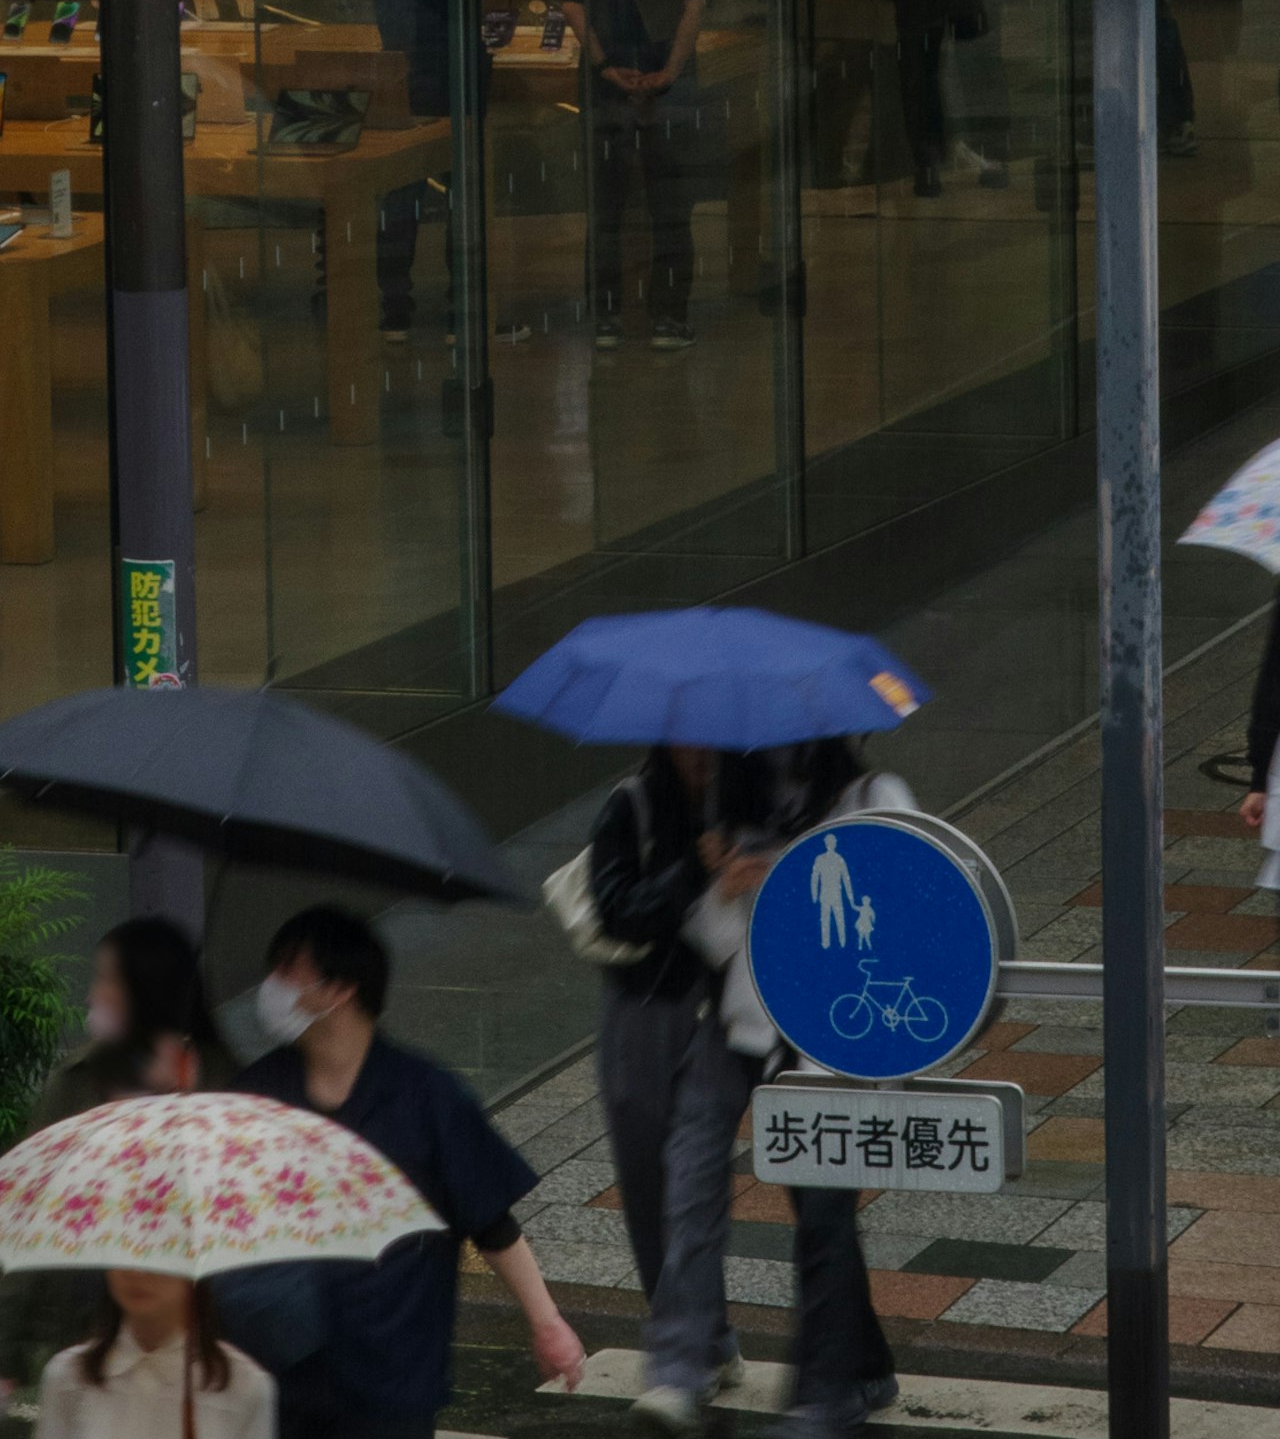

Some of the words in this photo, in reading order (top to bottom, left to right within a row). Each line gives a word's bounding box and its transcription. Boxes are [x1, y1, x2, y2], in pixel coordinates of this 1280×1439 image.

[130, 570, 162, 689] 防犯カメ
[765, 1110, 990, 1172] 歩行者優先
